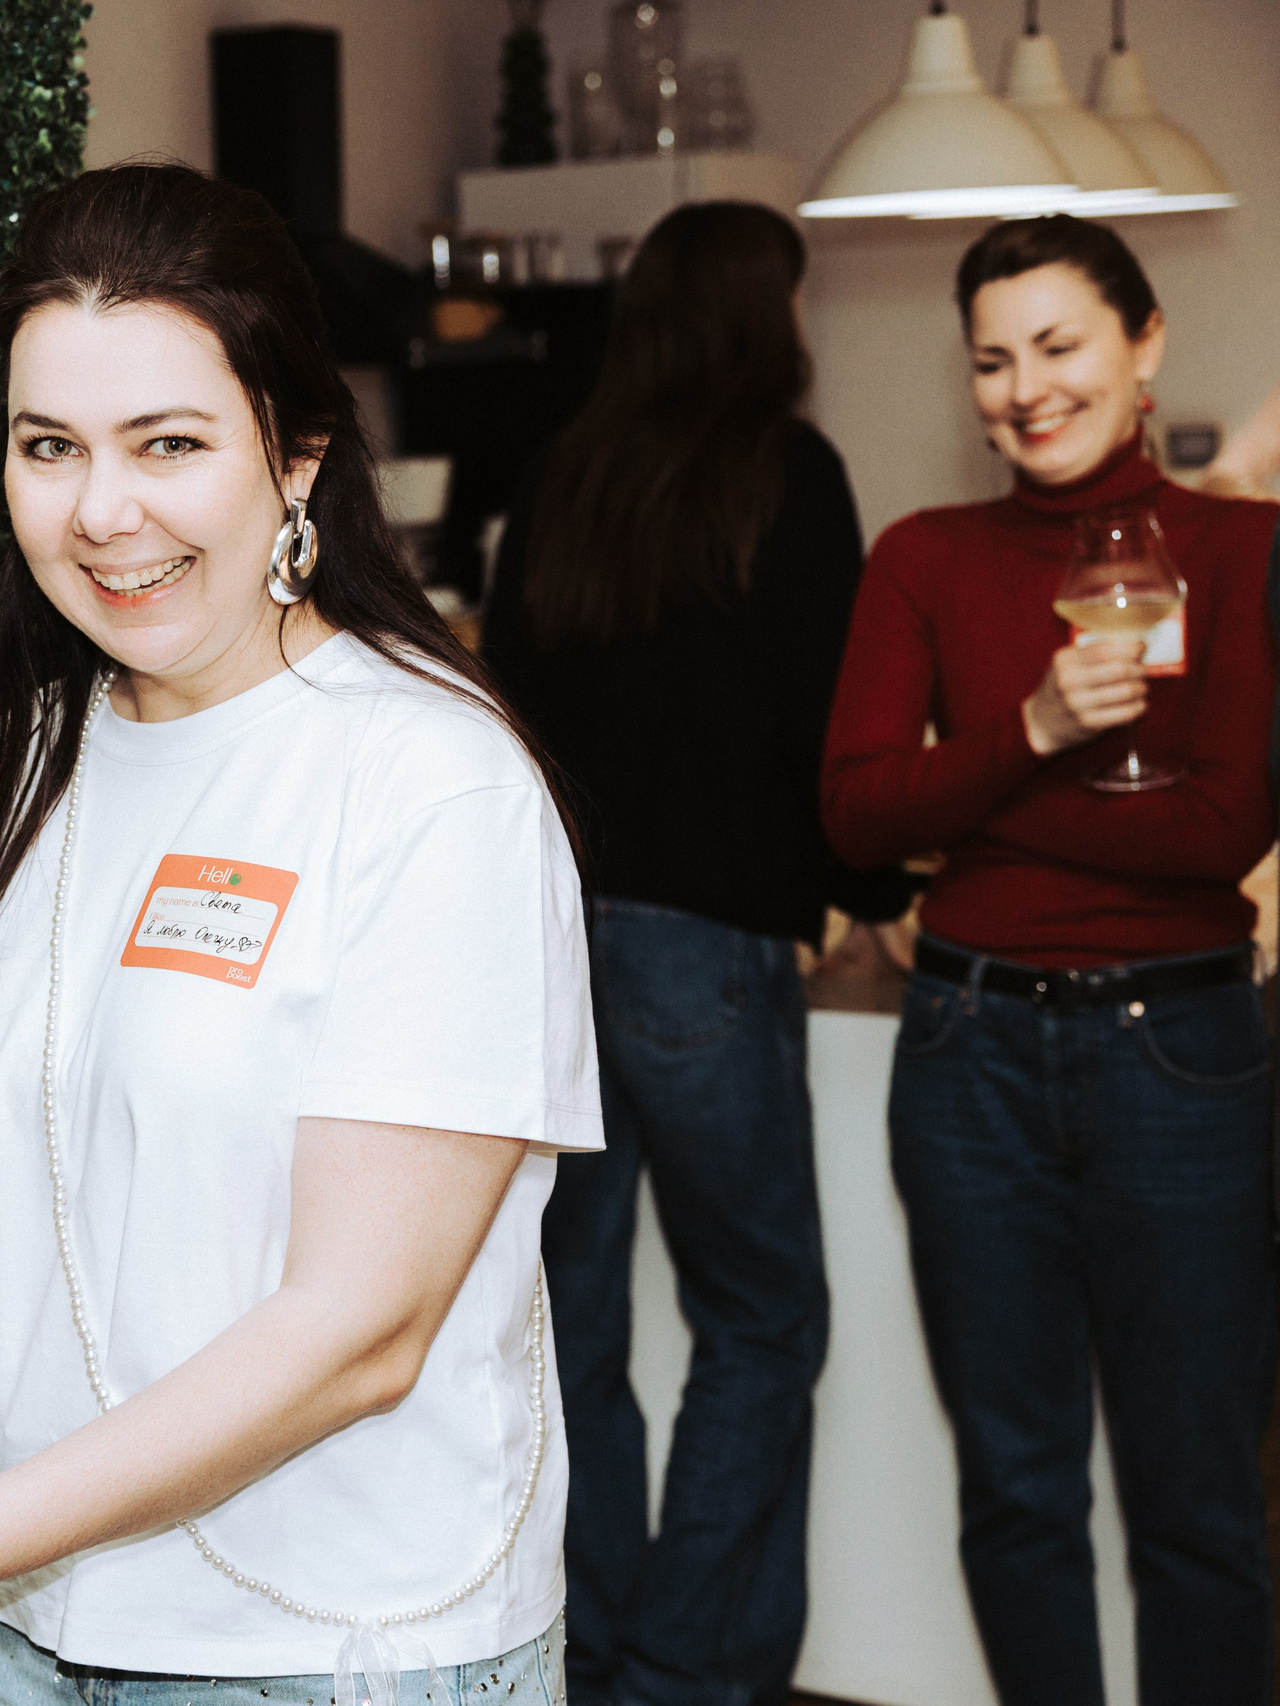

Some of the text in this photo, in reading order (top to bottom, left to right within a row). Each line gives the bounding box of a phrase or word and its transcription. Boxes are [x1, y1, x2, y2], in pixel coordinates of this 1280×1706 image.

[156, 897, 200, 908] my name is
[229, 966, 244, 975] pro
[226, 971, 252, 984] poest
